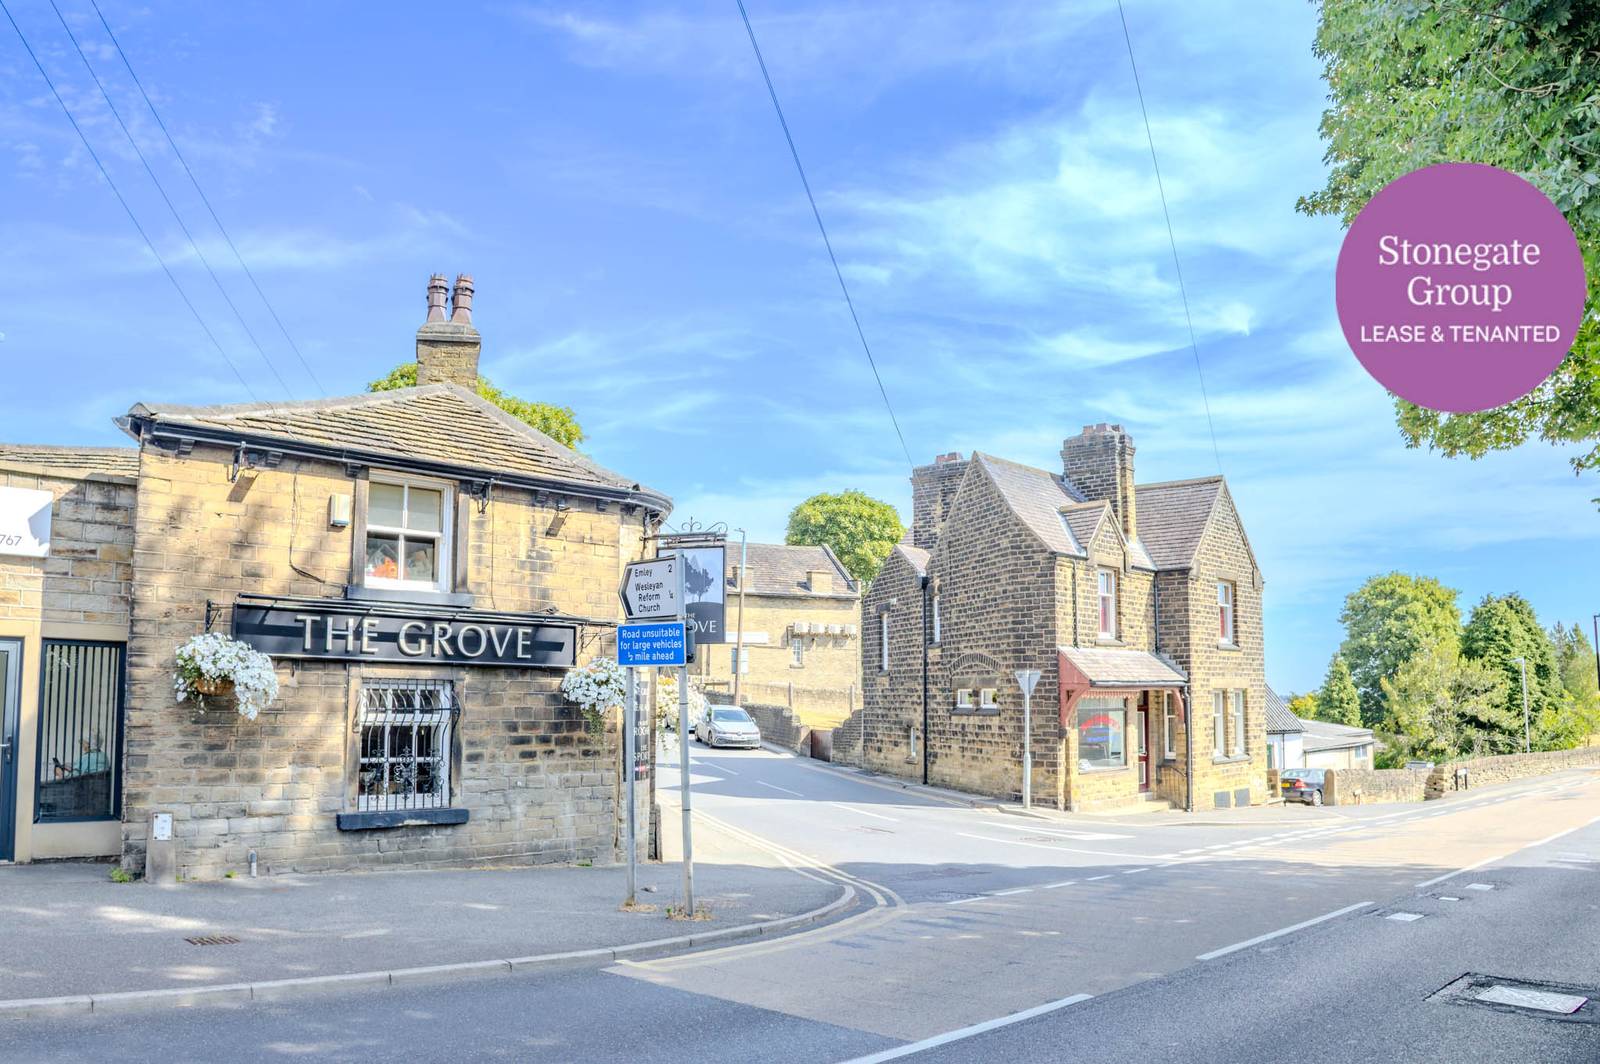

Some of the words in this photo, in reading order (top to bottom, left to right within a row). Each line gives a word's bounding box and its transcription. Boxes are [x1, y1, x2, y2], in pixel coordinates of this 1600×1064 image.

[634, 568, 653, 578] Emley
[667, 564, 673, 573] 2
[635, 581, 664, 592] Wesleyan
[638, 592, 661, 602] Reform
[638, 603, 661, 613] Church
[296, 614, 380, 653] THE
[398, 621, 533, 660] GROVE
[622, 629, 641, 639] Road
[641, 627, 681, 638] unsuitable
[620, 641, 631, 650] for
[632, 640, 651, 651] large
[652, 639, 682, 649] vehicles
[634, 651, 651, 661] mile
[651, 651, 675, 661] ahead
